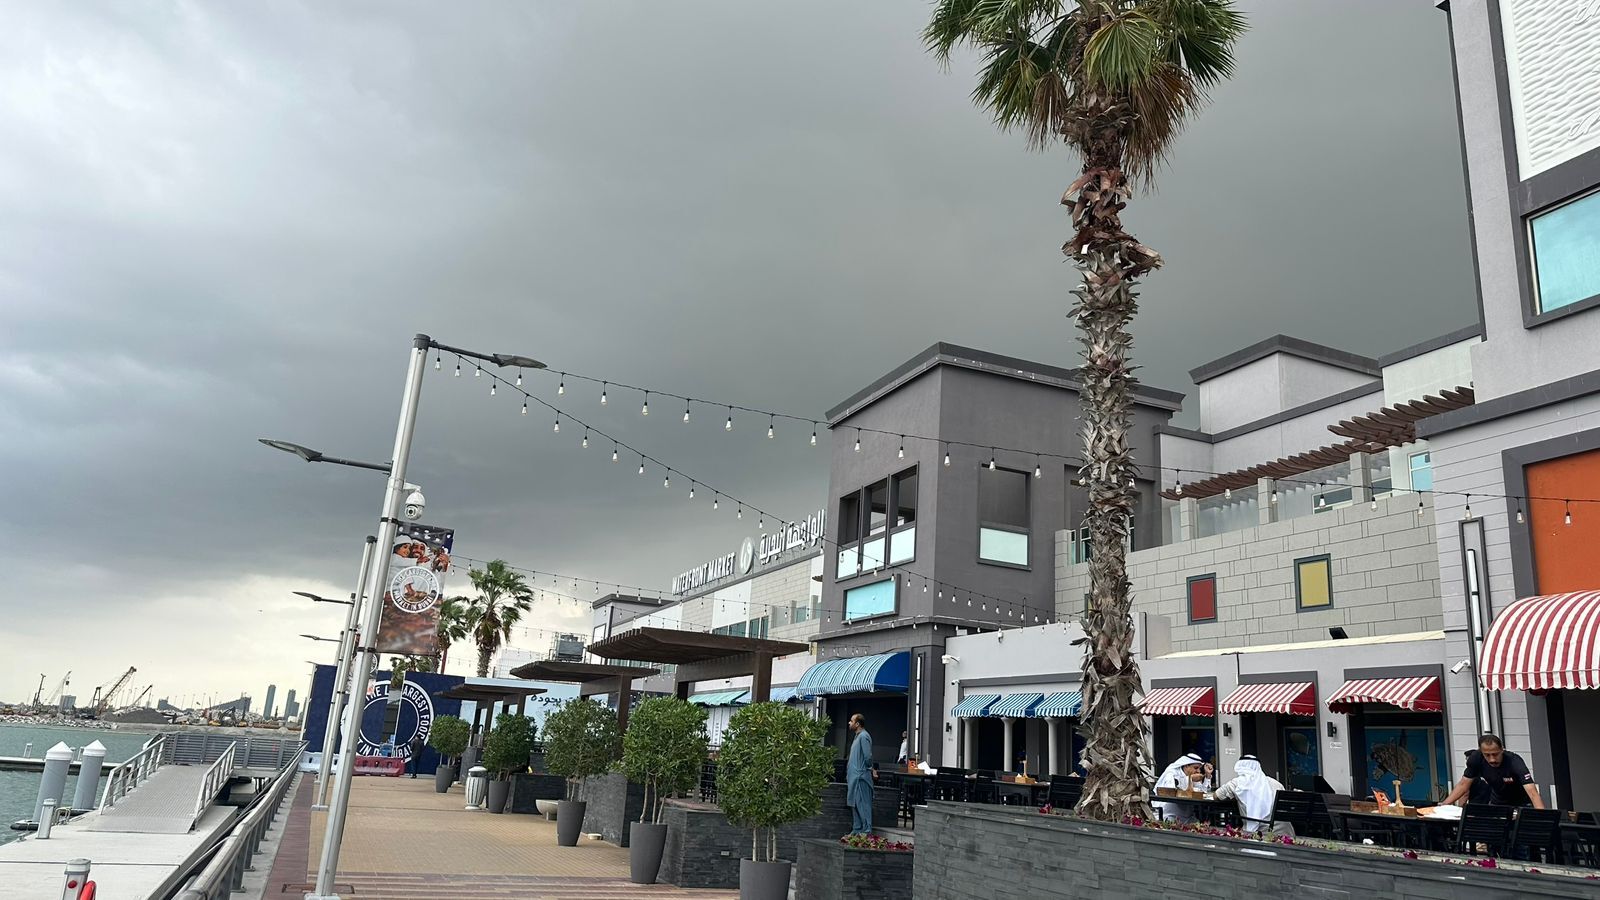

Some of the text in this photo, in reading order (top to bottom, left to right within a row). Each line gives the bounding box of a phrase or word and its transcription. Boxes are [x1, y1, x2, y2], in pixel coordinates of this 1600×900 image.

[759, 509, 825, 565] الواجهة البحرية
[672, 552, 735, 596] WATERFRONT MARKET
[384, 684, 429, 712] LARGEST
[359, 744, 372, 757] IN
